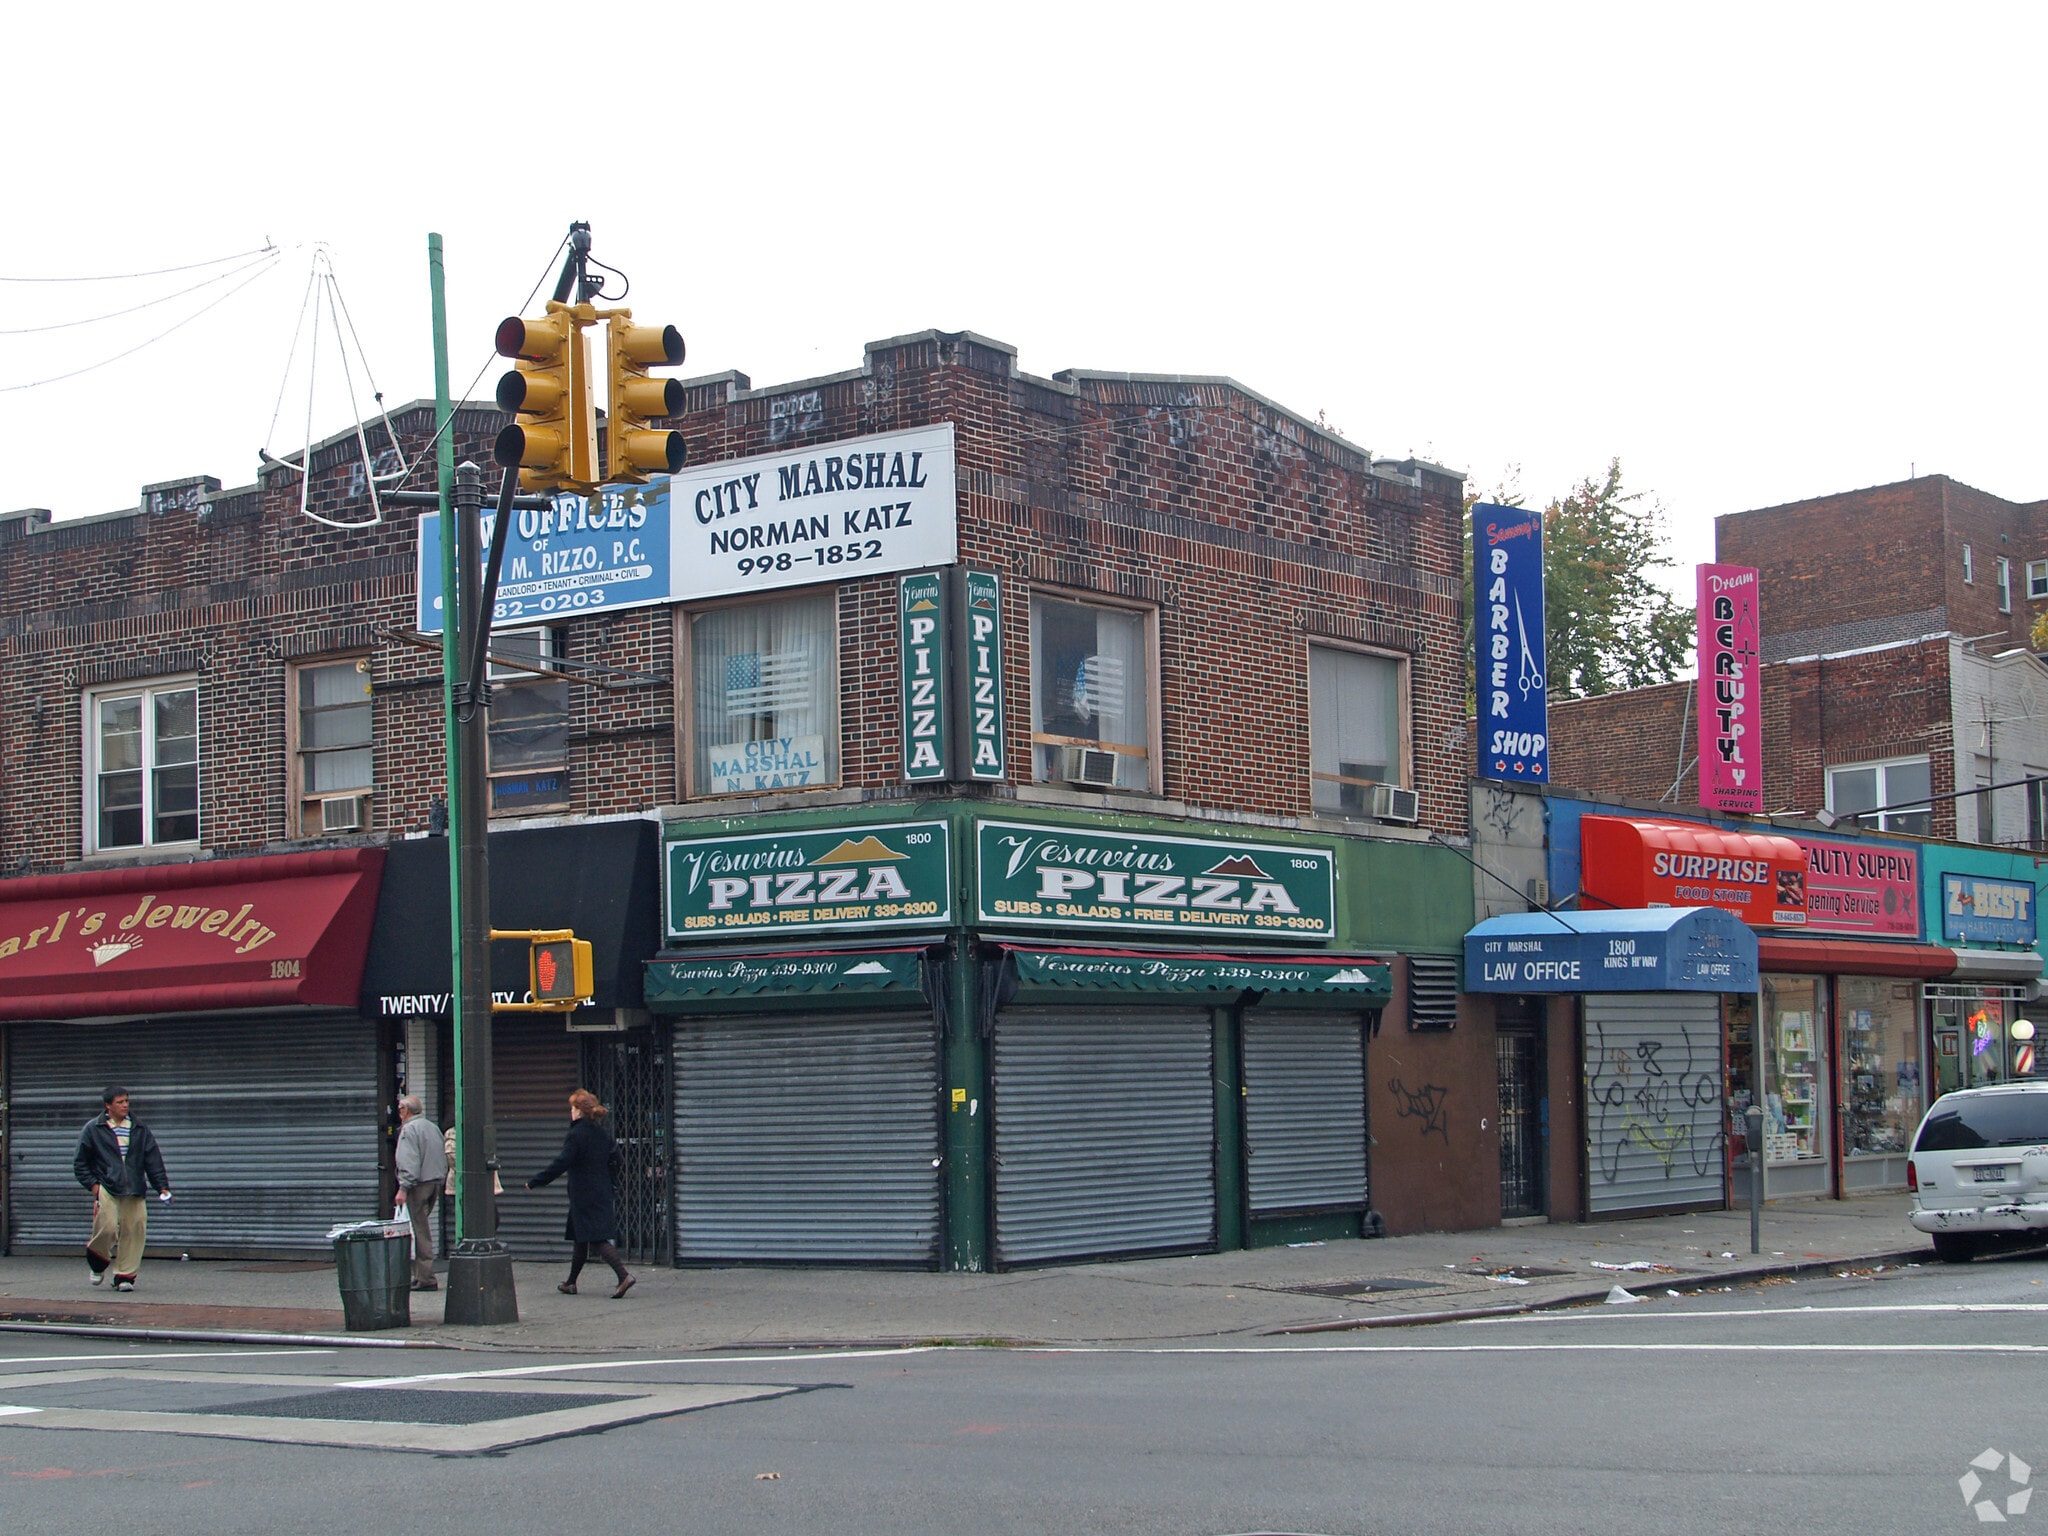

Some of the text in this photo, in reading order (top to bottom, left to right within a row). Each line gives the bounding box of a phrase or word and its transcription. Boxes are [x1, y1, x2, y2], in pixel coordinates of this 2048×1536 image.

[695, 451, 928, 525] CITY MARSHAL
[518, 492, 648, 539] OFFICES
[711, 502, 912, 555] NORMAN KATZ
[1486, 512, 1541, 545] Sammy's
[511, 557, 533, 580] M.
[542, 545, 604, 577] RIZZO,
[613, 538, 645, 565] P.C.
[533, 538, 549, 552] OF
[737, 539, 883, 576] 998-1852
[497, 569, 640, 598] LANDLORD TENANT CRIMINAL CIVIL
[905, 582, 938, 612] Vesuvius
[968, 581, 996, 606] Vesuvius
[1706, 572, 1754, 593] Dream
[494, 589, 605, 619] 82-0203
[1489, 548, 1510, 720] BARBER
[910, 617, 940, 768] PIZZA
[973, 614, 999, 766] PIZZA
[1714, 596, 1736, 764] BEAUTY
[1730, 662, 1746, 786] SUPPLY
[744, 737, 793, 759] CITY
[1491, 730, 1545, 758] SHOP
[712, 751, 819, 778] MARSHAL
[755, 770, 811, 790] KATZ
[1713, 787, 1759, 797] SHARPING
[1718, 799, 1754, 809] SERVICE
[905, 833, 931, 845] 1800
[683, 844, 806, 895] Vesuvius
[998, 836, 1176, 880] Vesuvius
[1289, 858, 1318, 870] 1800
[1653, 852, 1770, 885] SURPRISE
[1801, 846, 1912, 883] AUTY SUPPLY
[708, 866, 911, 910] PIZZA
[1036, 866, 1300, 914] PIZZA
[1675, 885, 1752, 903] FOOD STORE
[1973, 882, 2030, 920] BEST
[684, 901, 937, 928] SUBS SALADS FREE DELIVERY 339-9300
[994, 900, 1324, 930] SUBS SALADS FREE DELIVERY 339-9300
[1808, 892, 1880, 916] pening Service
[0, 895, 277, 960] arl's Jewelry
[1484, 940, 1543, 953] CITY MARSHAL
[1608, 939, 1636, 956] 1800
[270, 960, 300, 979] 1804
[670, 961, 838, 983] Vesuvius Pizza 339-9300
[1033, 955, 1310, 983] Vesuvius Pizza 339-9300
[1484, 961, 1581, 981] LAW OFFICE
[1604, 956, 1628, 969] KINGS
[1697, 964, 1730, 976] LAW OFFICE
